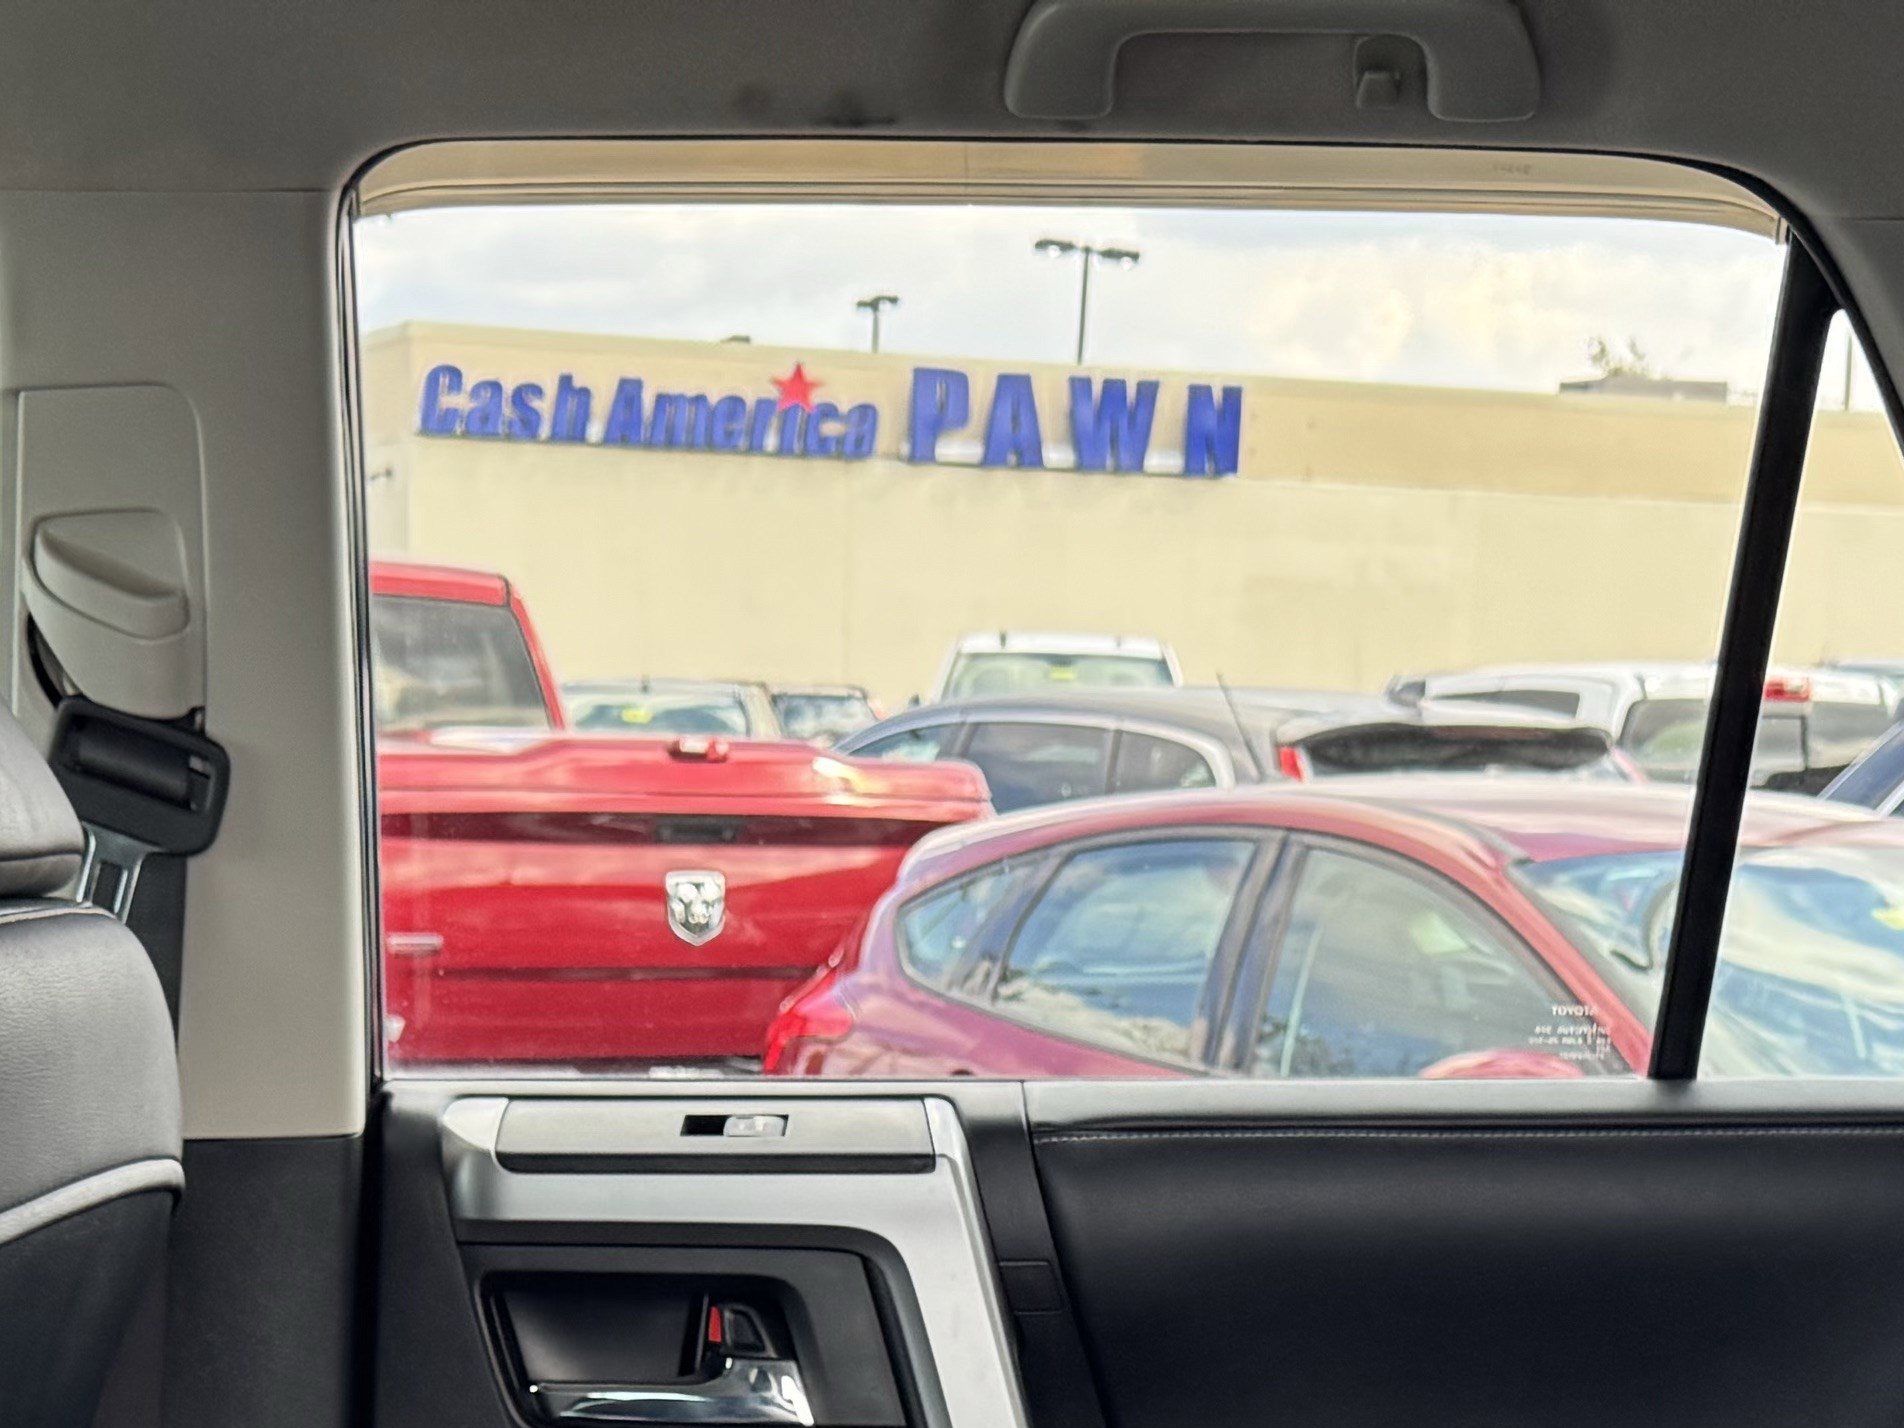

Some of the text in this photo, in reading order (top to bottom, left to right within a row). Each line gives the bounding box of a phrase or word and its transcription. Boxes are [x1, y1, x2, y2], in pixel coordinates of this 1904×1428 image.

[419, 364, 1243, 476] Cash America PAWN
